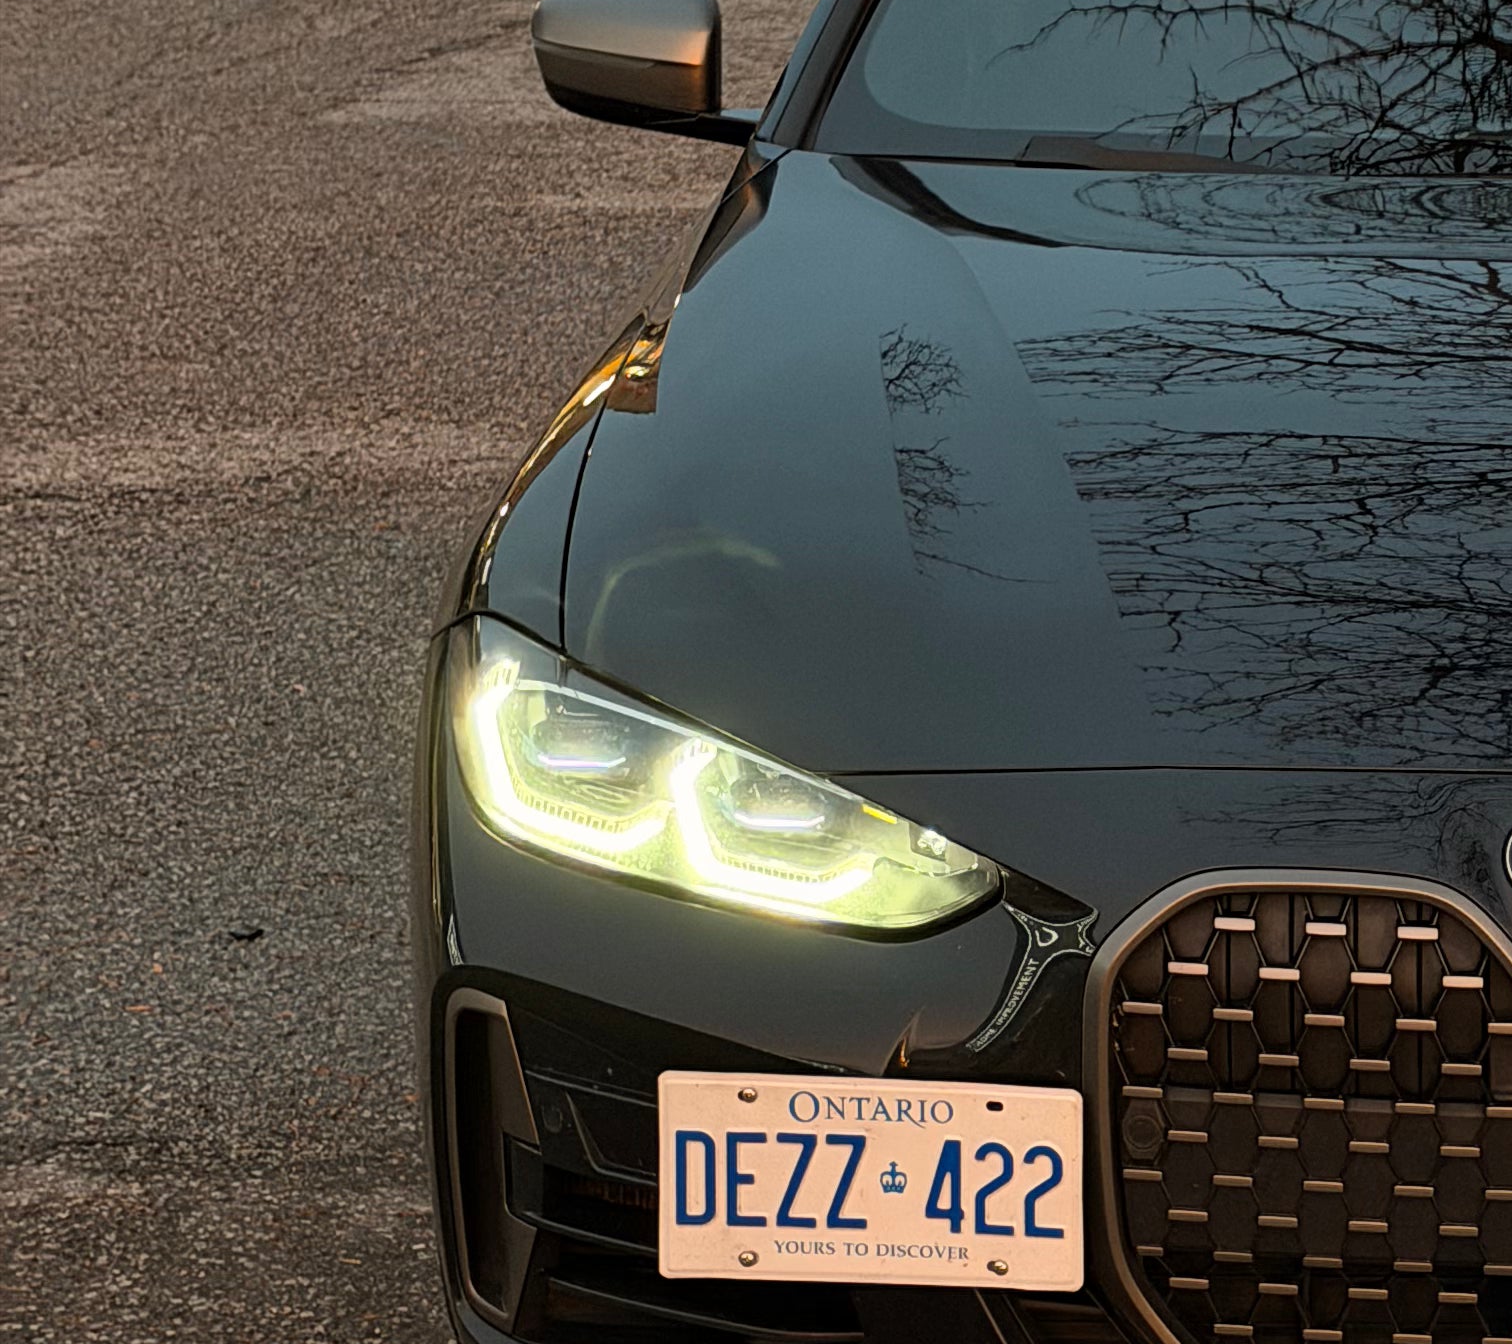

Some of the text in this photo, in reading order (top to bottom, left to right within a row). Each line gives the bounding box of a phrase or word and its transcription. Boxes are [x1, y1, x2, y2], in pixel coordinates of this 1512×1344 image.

[788, 1090, 954, 1128] ONTARIO
[674, 1130, 1065, 1239] DEZZ 422
[773, 1239, 970, 1262] YOURS TO DISCOVER
